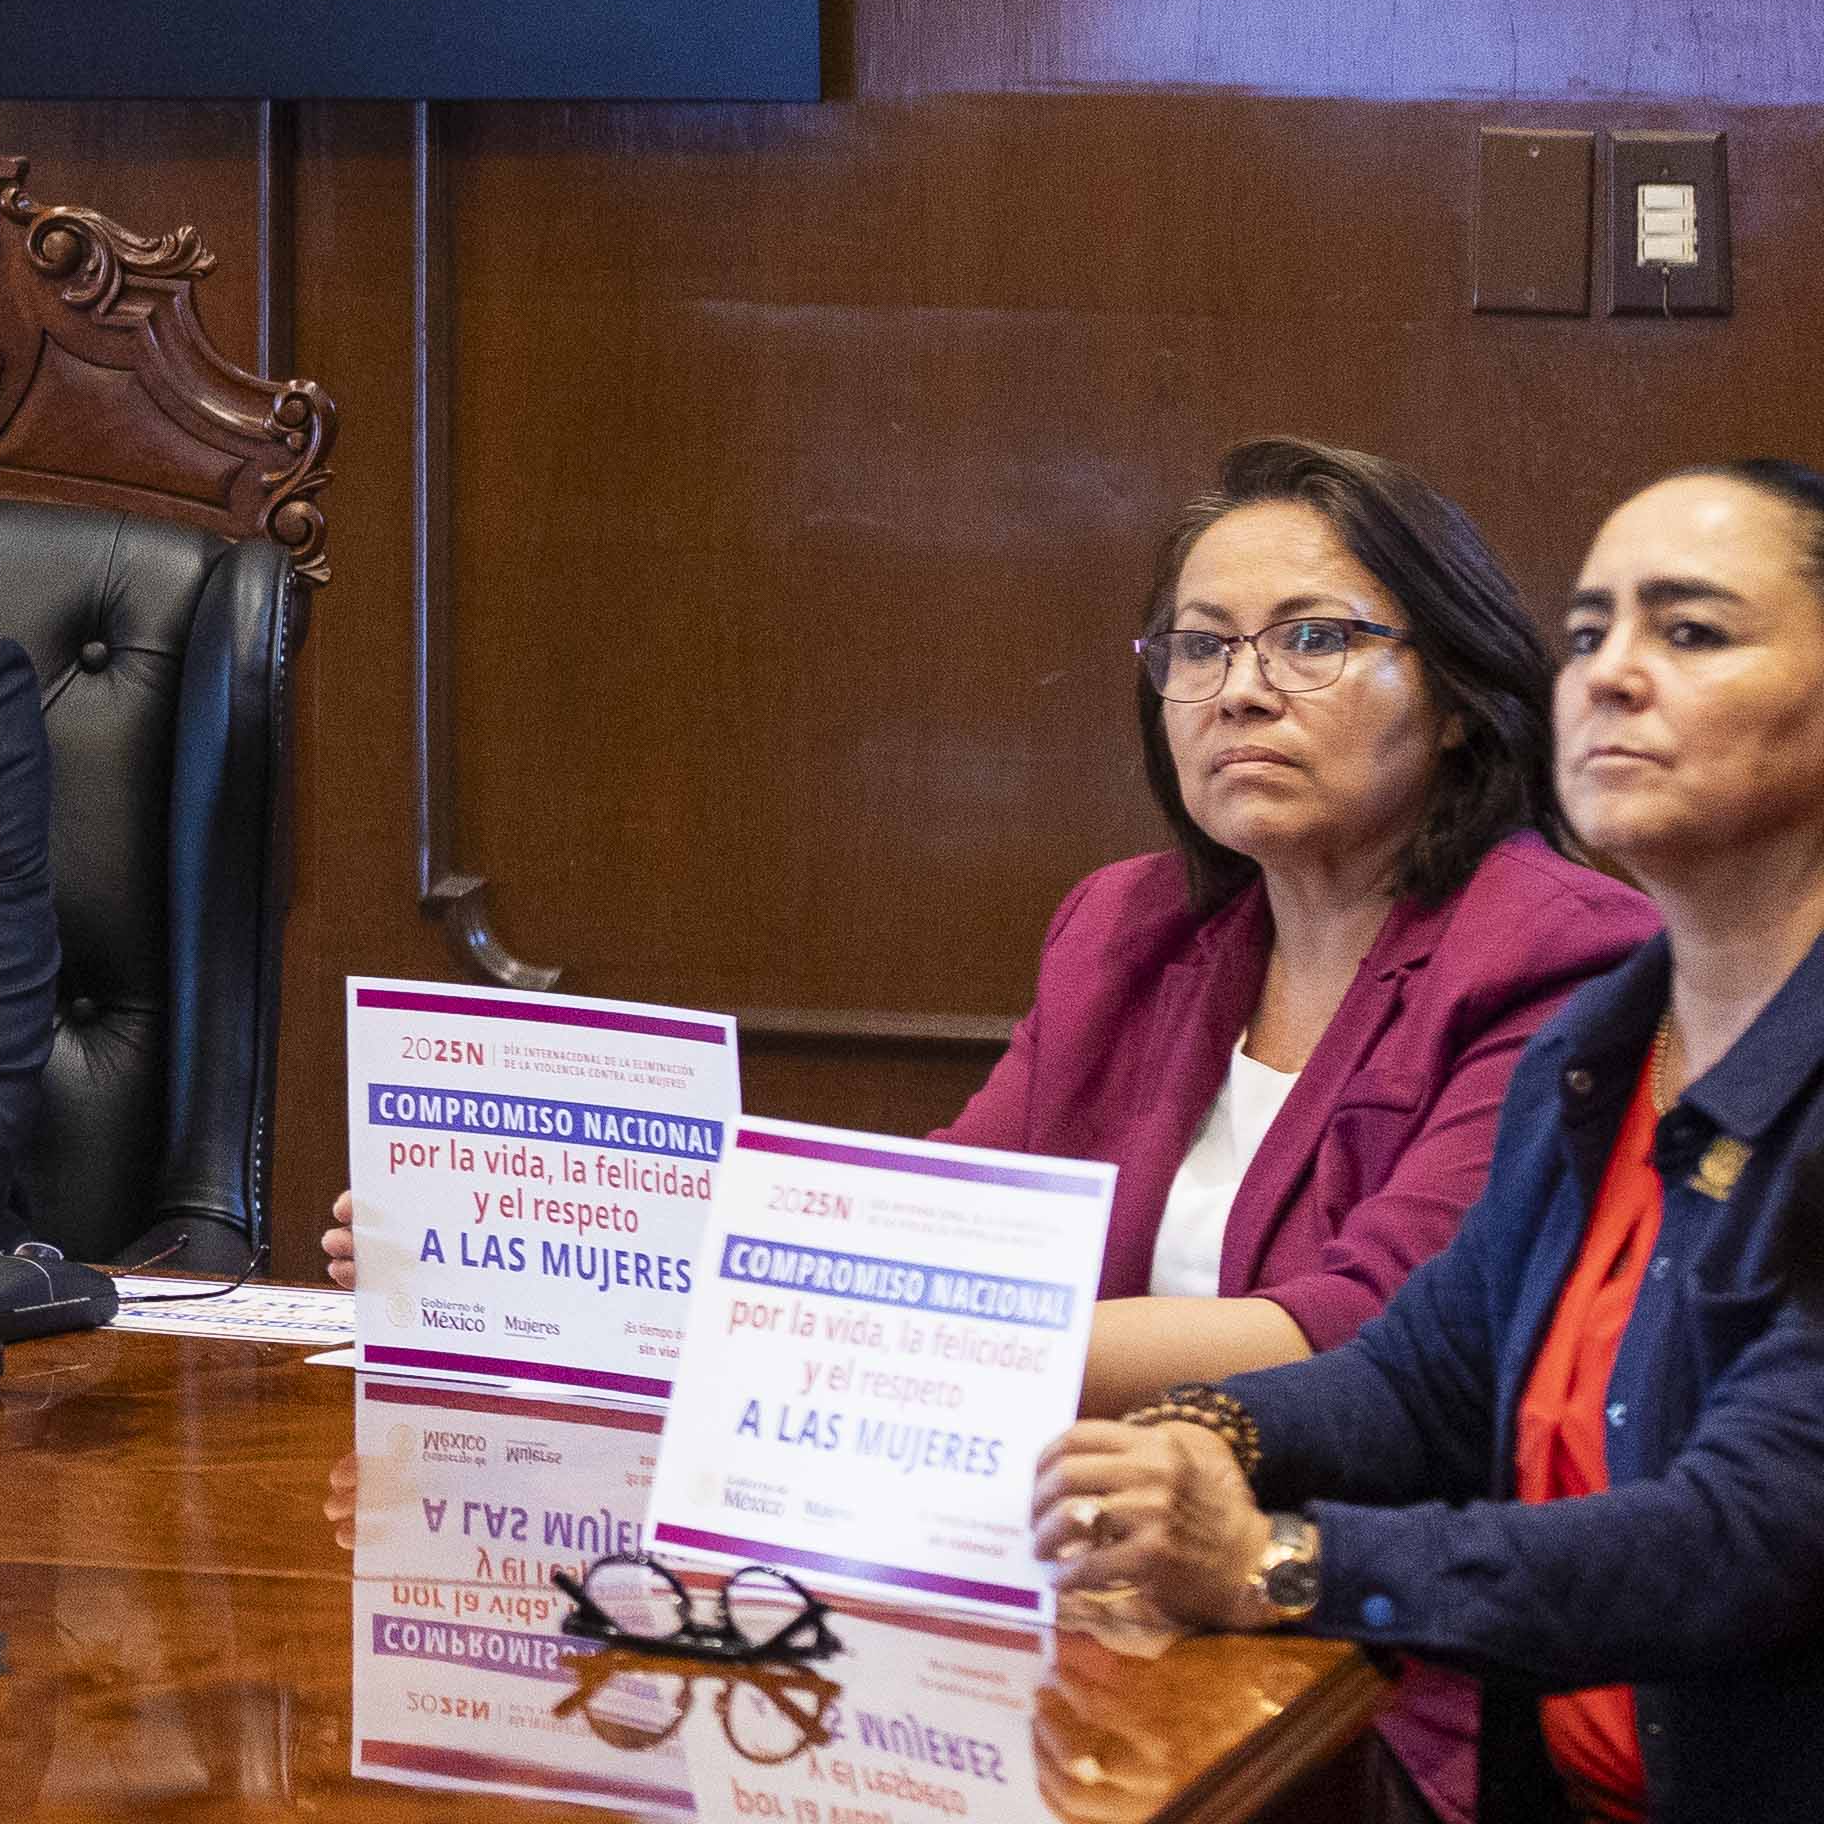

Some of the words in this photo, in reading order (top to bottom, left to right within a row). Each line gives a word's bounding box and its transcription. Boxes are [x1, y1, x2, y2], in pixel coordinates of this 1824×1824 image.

[400, 1033, 485, 1068] 2025N
[377, 1088, 574, 1140] COMPROMISO
[582, 1110, 718, 1157] NACIONAL
[388, 1138, 442, 1179] por
[449, 1138, 474, 1173] la
[483, 1141, 554, 1185] vida,
[561, 1150, 587, 1185] la
[594, 1154, 713, 1201] felicidad
[472, 1190, 491, 1225] y
[497, 1185, 524, 1220] el
[532, 1194, 640, 1242] respeto
[418, 1226, 445, 1264] A
[459, 1231, 527, 1273] LAS
[541, 1240, 693, 1301] MUJERES
[421, 1307, 486, 1334] México
[503, 1314, 560, 1338] Mujeres
